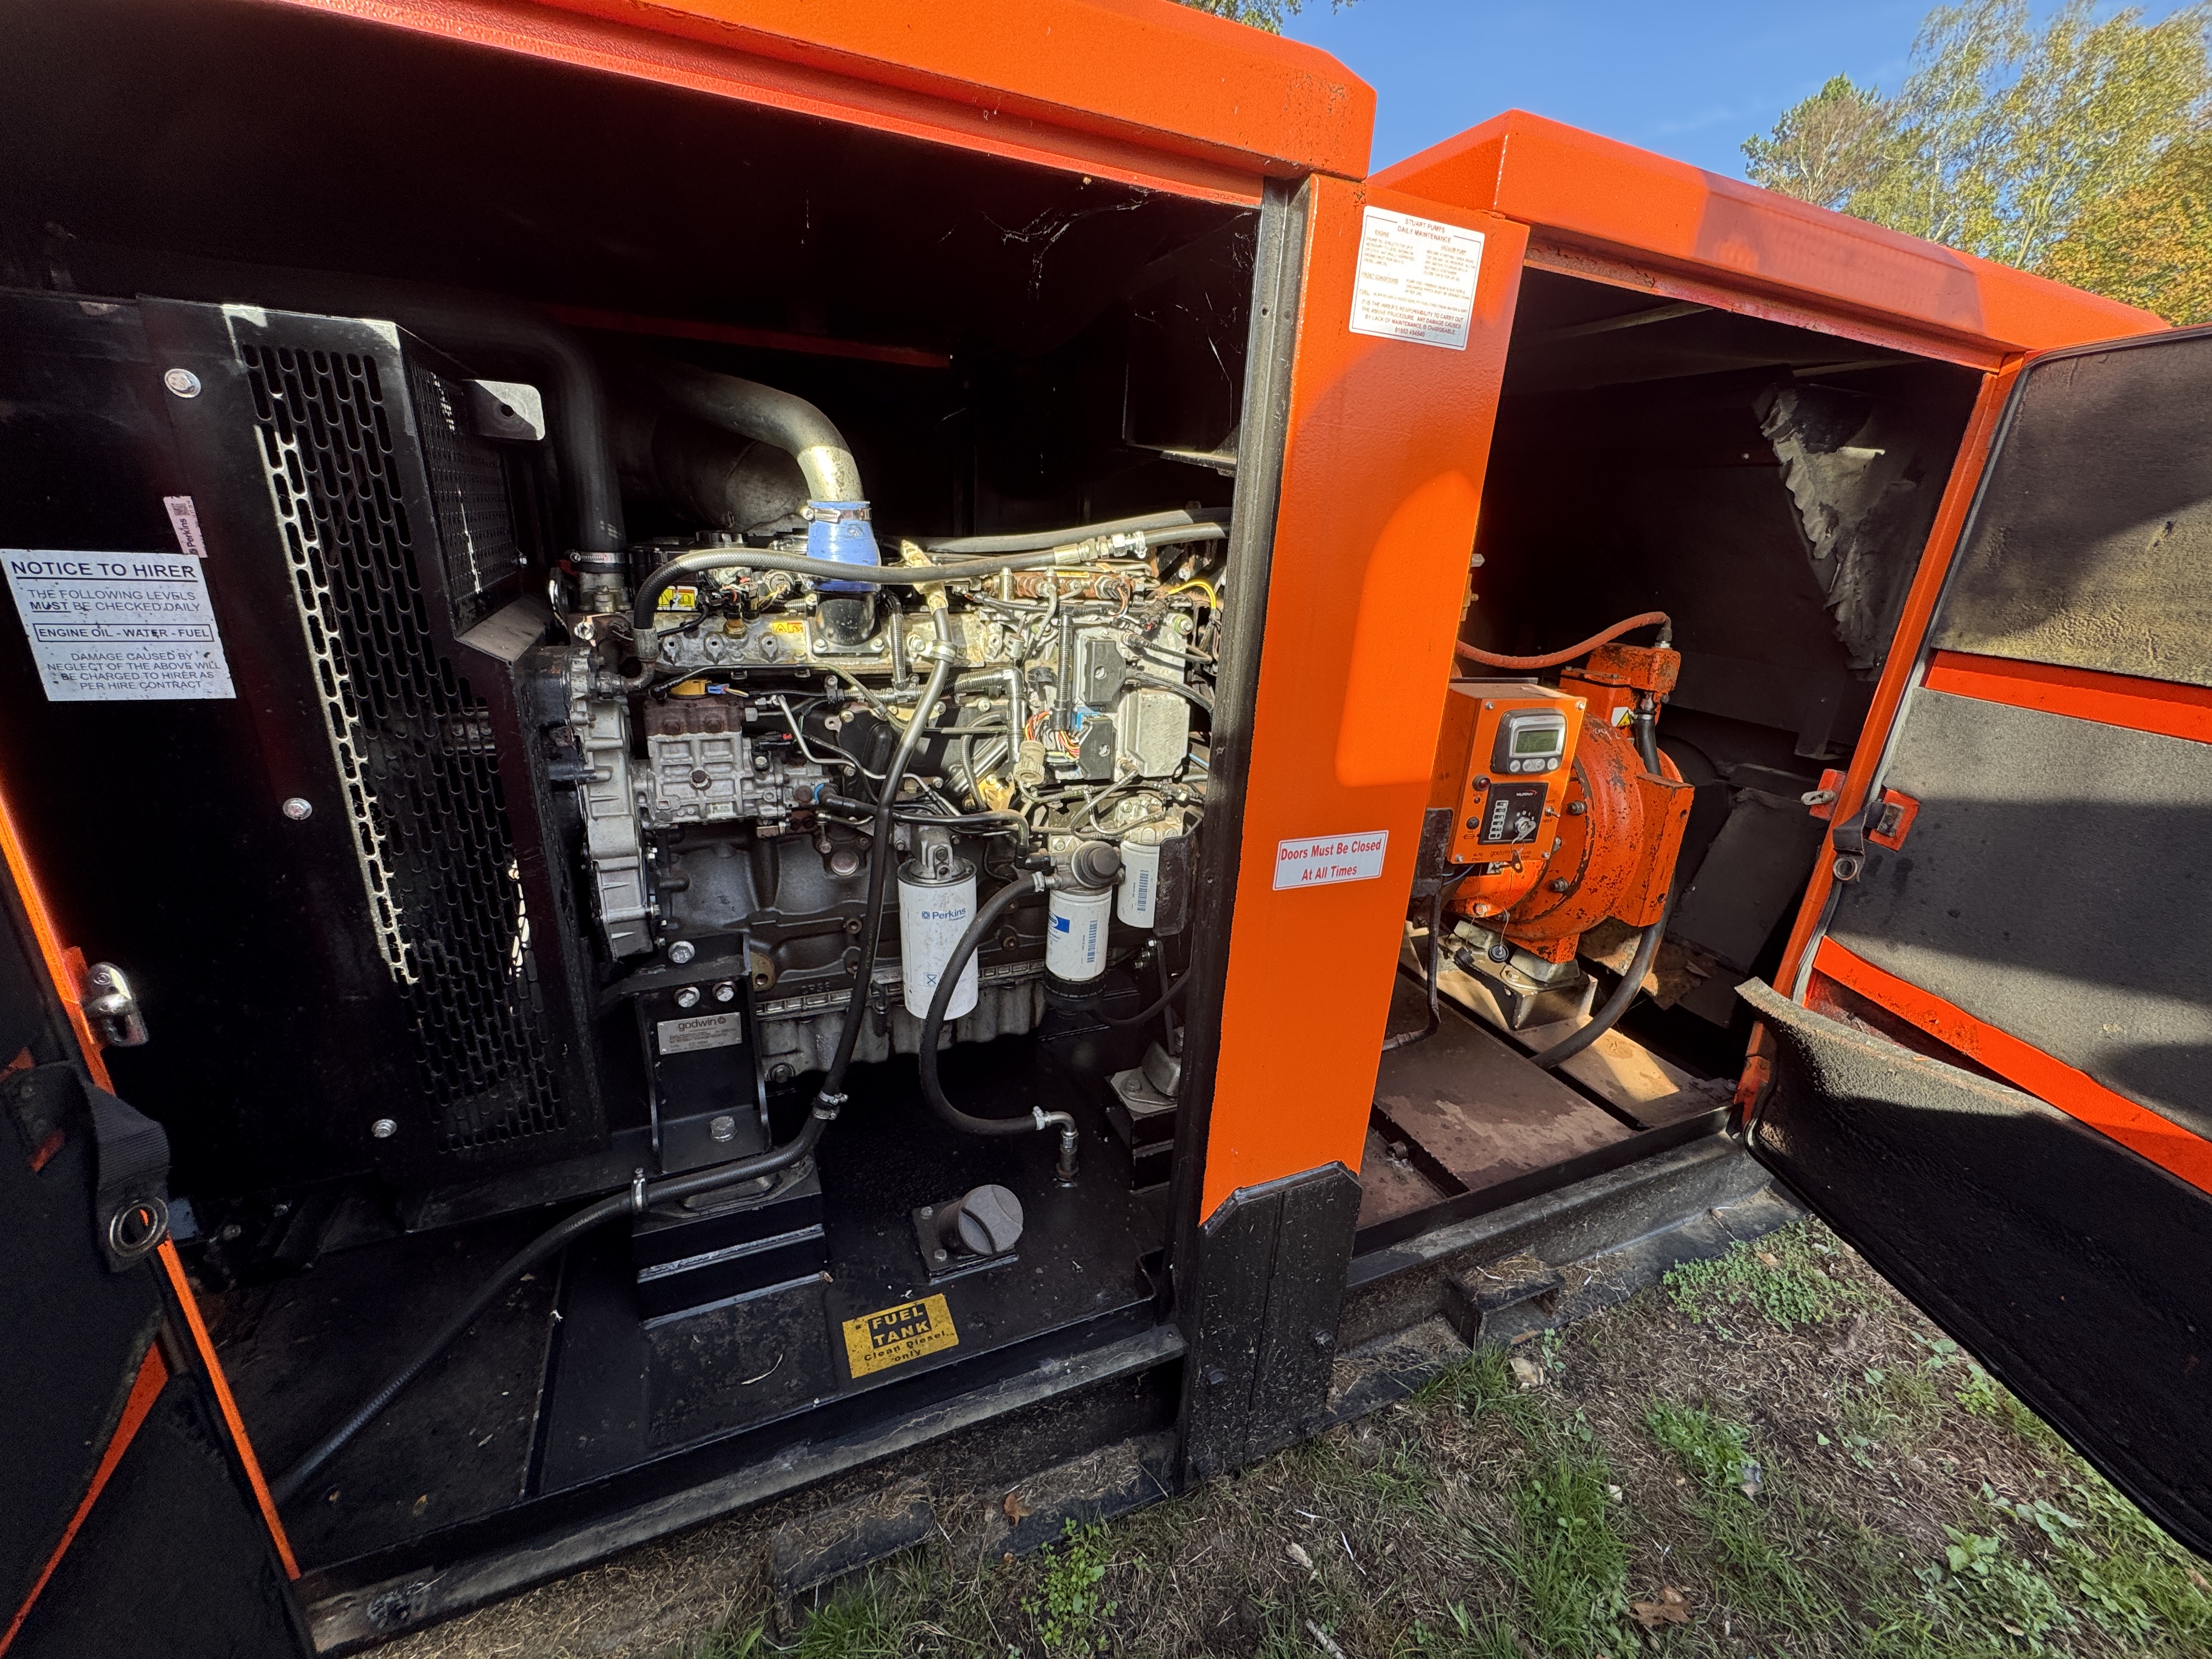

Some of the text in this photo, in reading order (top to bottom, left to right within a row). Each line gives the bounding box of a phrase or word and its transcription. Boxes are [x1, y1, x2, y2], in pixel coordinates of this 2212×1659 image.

[1404, 218, 1445, 233] STUART PUMPS
[1397, 225, 1413, 234] DAILY
[1414, 229, 1451, 243] MAINTENANCE
[179, 518, 197, 548] Perkins
[11, 561, 196, 578] NOTICE TO HIRER
[27, 589, 196, 601] THE FOLLOWING LEVELS
[30, 601, 200, 612] MUST BE CHECKED DAILY
[40, 629, 88, 637] ENGINE
[92, 628, 114, 637] OIL
[123, 629, 168, 637] WATER
[179, 629, 209, 637] FUEL
[127, 652, 175, 661] CAUSED
[139, 680, 202, 690] CONTRACT
[1280, 838, 1382, 861] Doors Must Be Closed
[1301, 865, 1357, 881] At All Times
[932, 908, 966, 919] Perkins
[678, 1017, 716, 1032] godwin
[872, 1307, 924, 1329] FUEL
[873, 1321, 930, 1346] TANK
[864, 1330, 945, 1361] Clean Diesel
[894, 1349, 921, 1362] only
